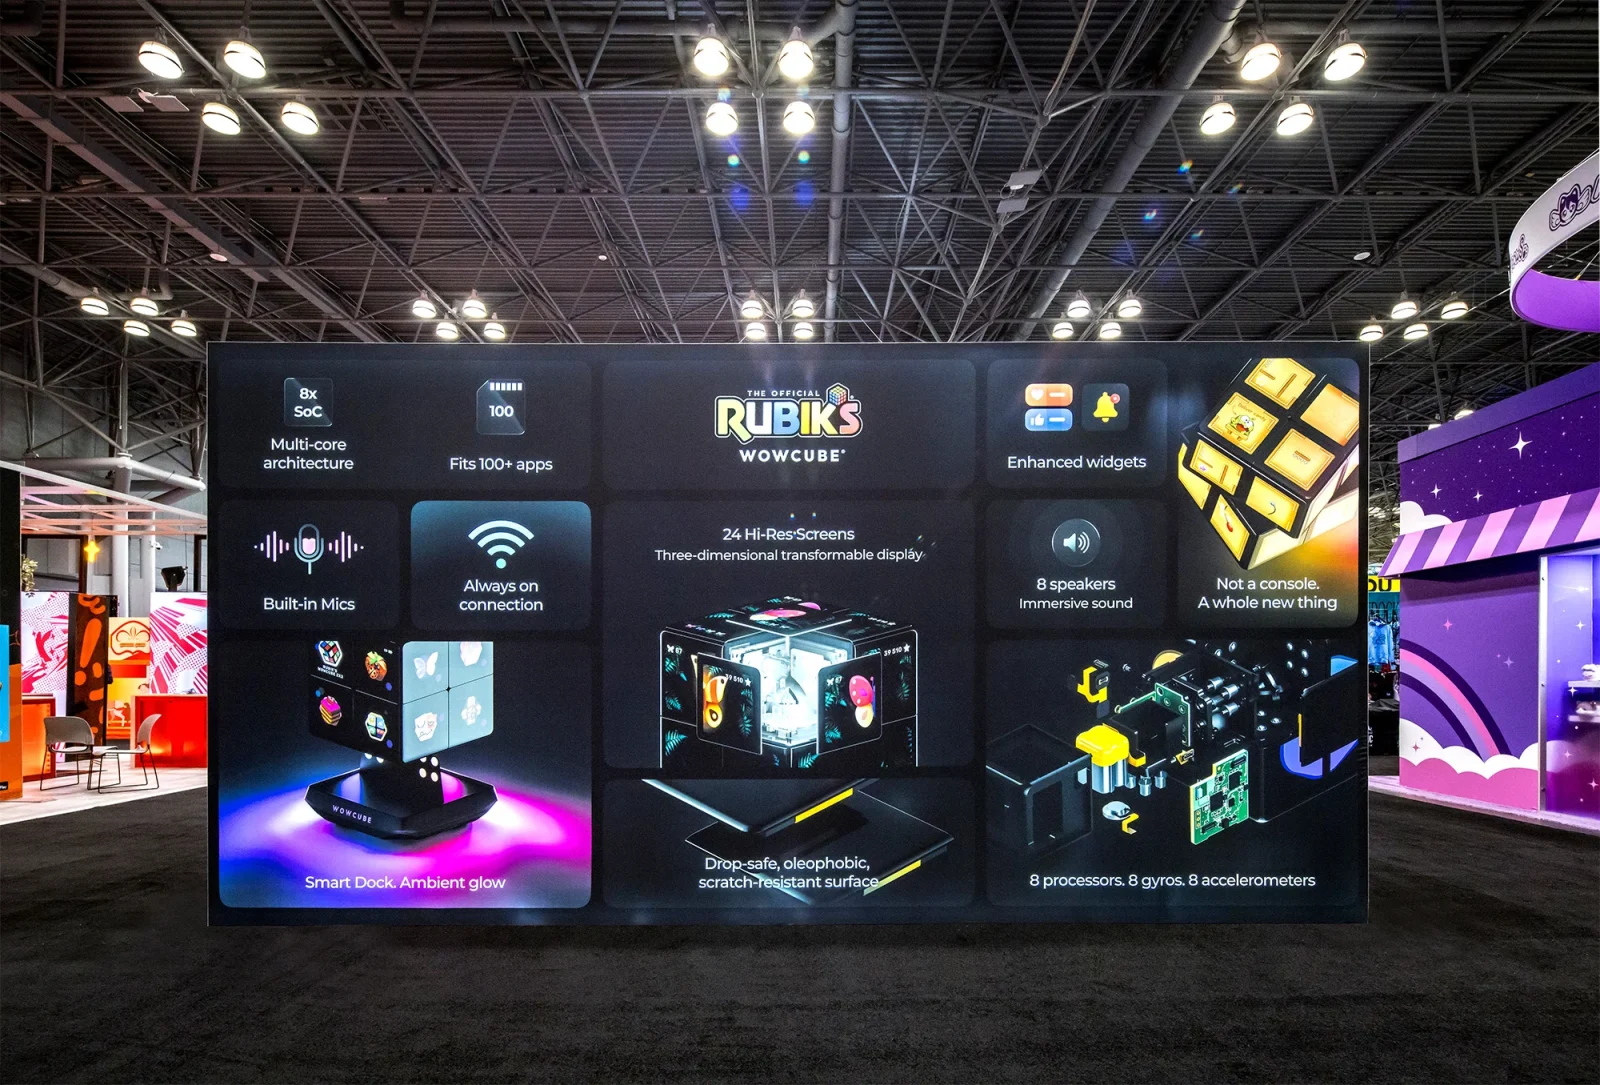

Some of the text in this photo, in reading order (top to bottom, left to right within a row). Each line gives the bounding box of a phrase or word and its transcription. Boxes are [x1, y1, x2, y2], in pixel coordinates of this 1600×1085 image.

[300, 388, 317, 399] 8x
[294, 406, 322, 417] SoC
[489, 405, 514, 417] 100
[272, 438, 346, 450] Multi-core
[264, 456, 354, 469] architecture
[450, 457, 553, 473] Fits 100+ apps
[1008, 455, 1146, 470] Enhanced widgets
[723, 528, 855, 540] 24 Hi-Res Screens
[655, 548, 923, 562] Three-dimensional transformable display
[464, 579, 538, 595] Always on
[1037, 577, 1115, 593] 8 speakers
[1218, 577, 1319, 589] Not a console.
[264, 597, 355, 610] Built-in Mics
[459, 598, 543, 610] connection
[1020, 597, 1132, 608] Immersive sound
[1198, 596, 1337, 611] A whole new thing
[332, 804, 372, 824] WOWCUBE
[705, 856, 869, 872] Drop-safe, oleophobic,
[304, 875, 506, 891] Smart Dock. Ambient glow
[699, 874, 880, 890] scratch-resistant surface
[1030, 874, 1315, 889] 8 processors. 8 gyros. 8 accelerometers
